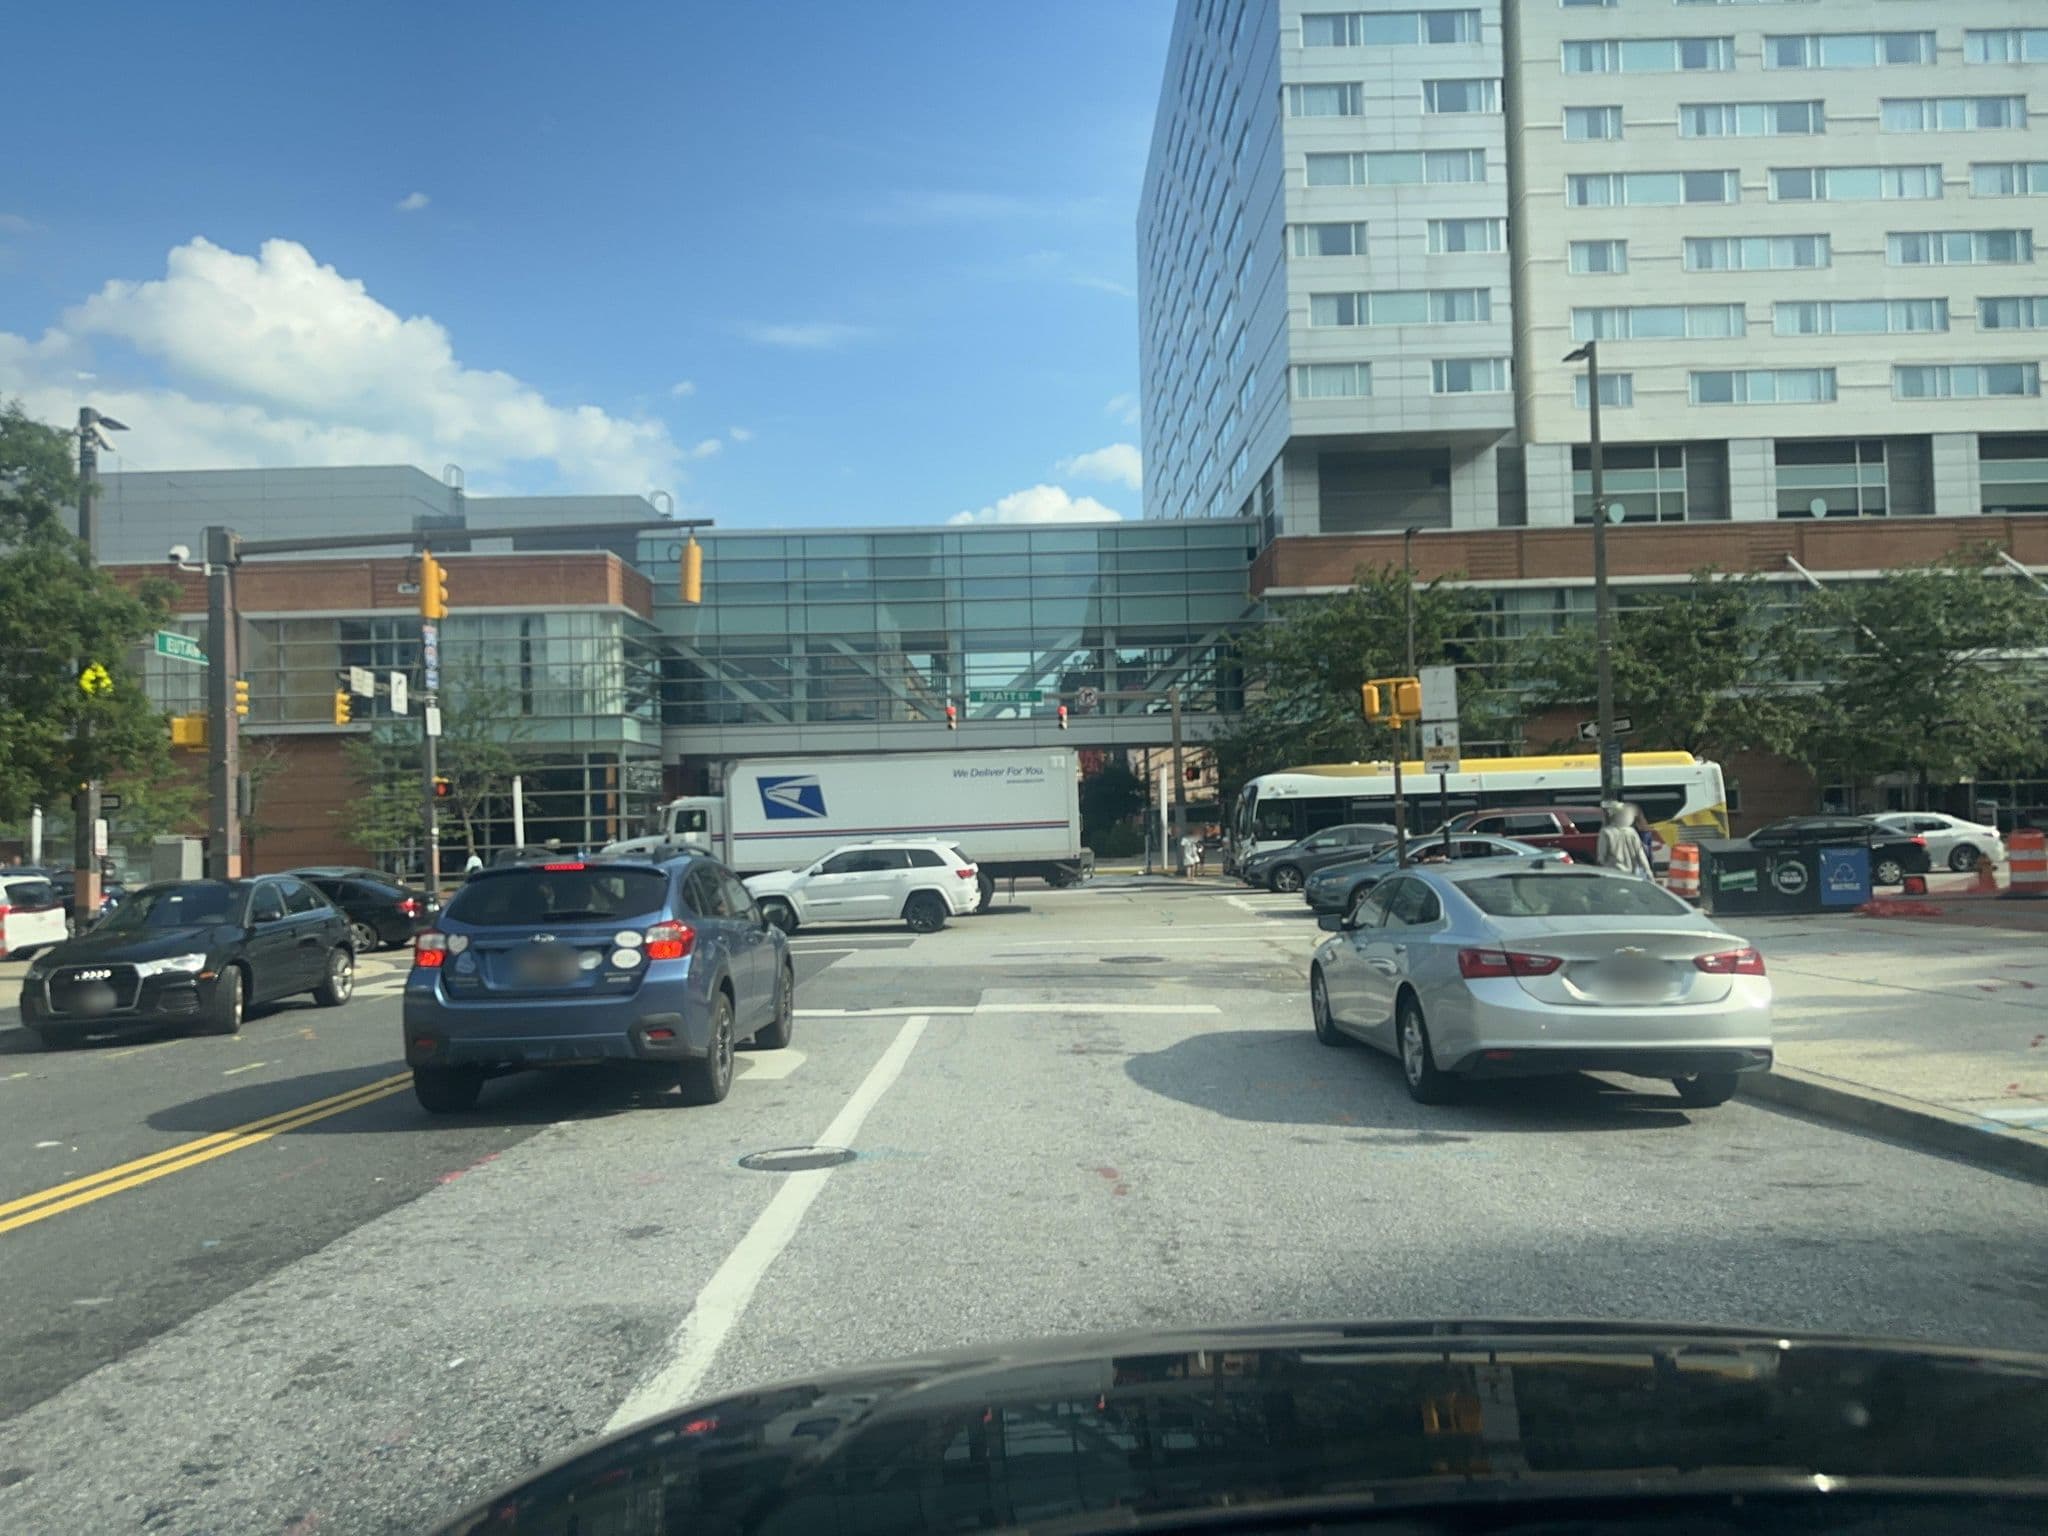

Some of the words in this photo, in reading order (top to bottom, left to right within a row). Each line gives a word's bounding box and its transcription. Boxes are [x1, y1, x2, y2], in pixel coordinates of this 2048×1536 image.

[980, 691, 1016, 701] PRATT
[953, 768, 968, 778] We
[970, 768, 1005, 778] Deliver
[1006, 767, 1023, 776] For
[1024, 766, 1044, 775] You.
